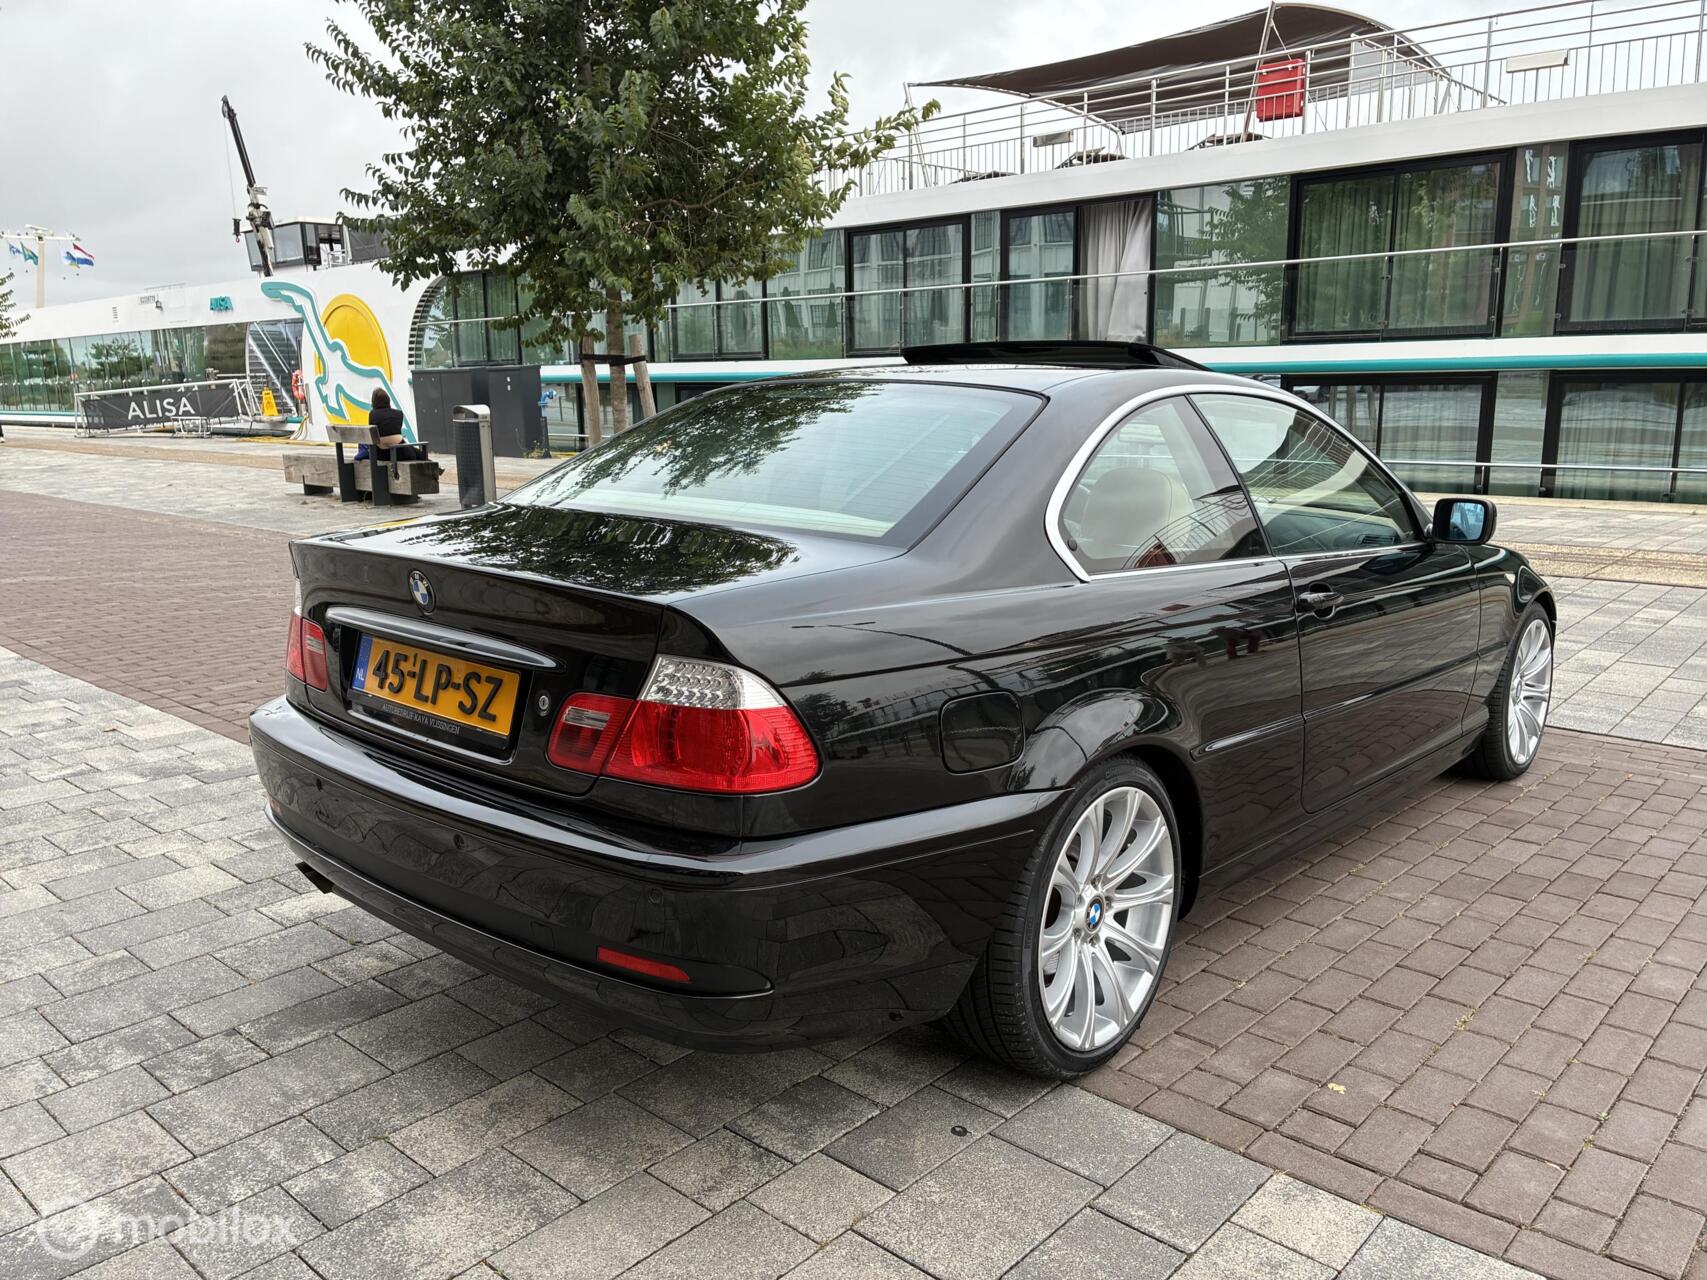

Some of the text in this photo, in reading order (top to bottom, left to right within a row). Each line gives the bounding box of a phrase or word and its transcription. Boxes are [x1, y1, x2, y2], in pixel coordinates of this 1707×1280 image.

[128, 397, 196, 420] ALISA
[355, 668, 365, 681] NL
[372, 650, 504, 722] 45-LP-SZ
[382, 703, 460, 735] AUTOBEDRIJF KAYA VLISSINGEN
